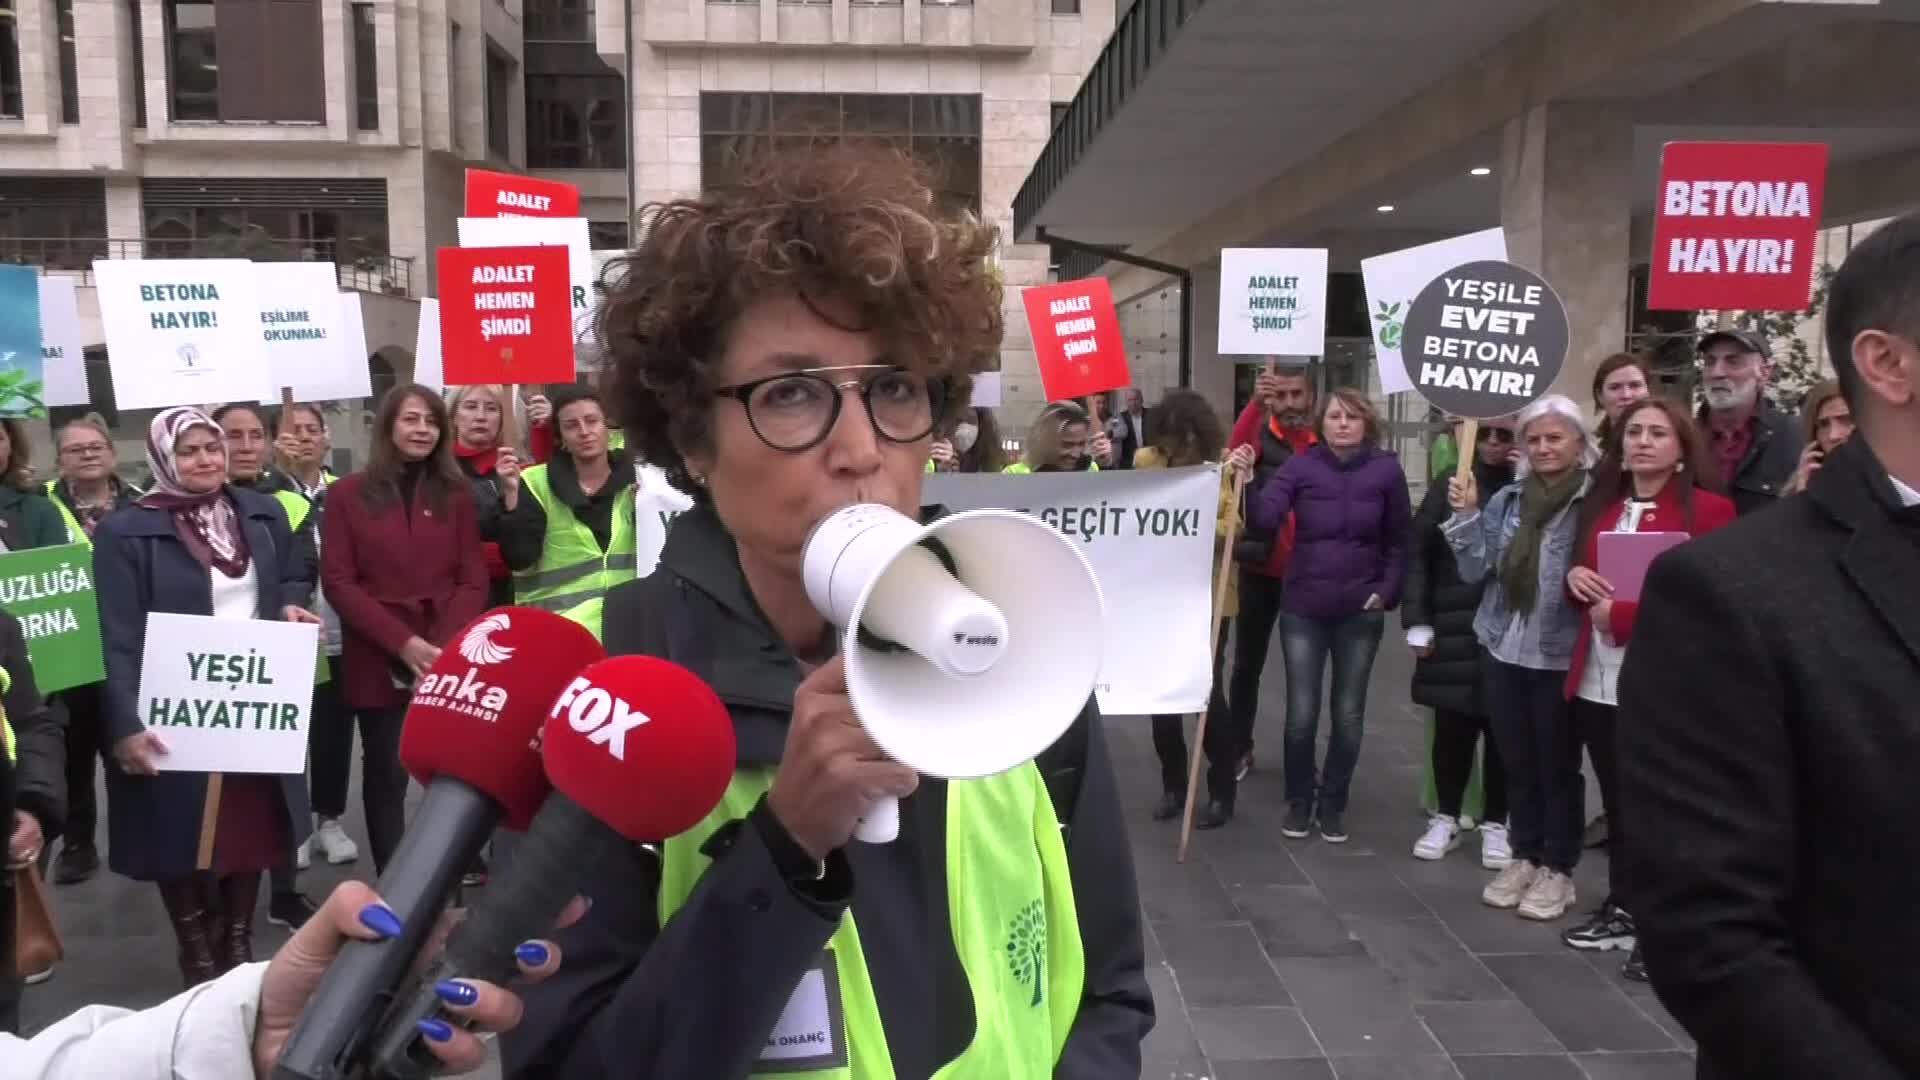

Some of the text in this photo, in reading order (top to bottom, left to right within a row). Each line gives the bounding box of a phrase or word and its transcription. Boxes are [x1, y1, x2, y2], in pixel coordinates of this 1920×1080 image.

[497, 190, 552, 211] ADALET
[1663, 180, 1811, 218] BETONA
[1668, 238, 1794, 274] HAYIR!
[472, 265, 536, 285] ADALET
[1248, 276, 1299, 289] ADALET
[139, 283, 220, 302] BETONA
[474, 292, 536, 310] HEMEN
[1050, 295, 1092, 316] ADALET
[1249, 297, 1297, 310] HEMEN
[151, 311, 219, 329] HAYIR!
[480, 314, 531, 341] ŞİMDİ
[1055, 316, 1096, 336] HEMEN
[1252, 314, 1292, 332] ŞİMDİ
[1440, 304, 1536, 336] EVET
[1064, 335, 1098, 361] ŞİMDİ
[1422, 335, 1541, 367] BETONA
[1419, 362, 1536, 397] HAYIR!
[1041, 501, 1200, 543] GEÇİT YOK!
[0, 562, 94, 604] UZLUĞA
[187, 648, 274, 691] YEŞİL
[419, 667, 508, 712] anka
[149, 697, 300, 731] HAYATTIR
[551, 676, 652, 761] FOX
